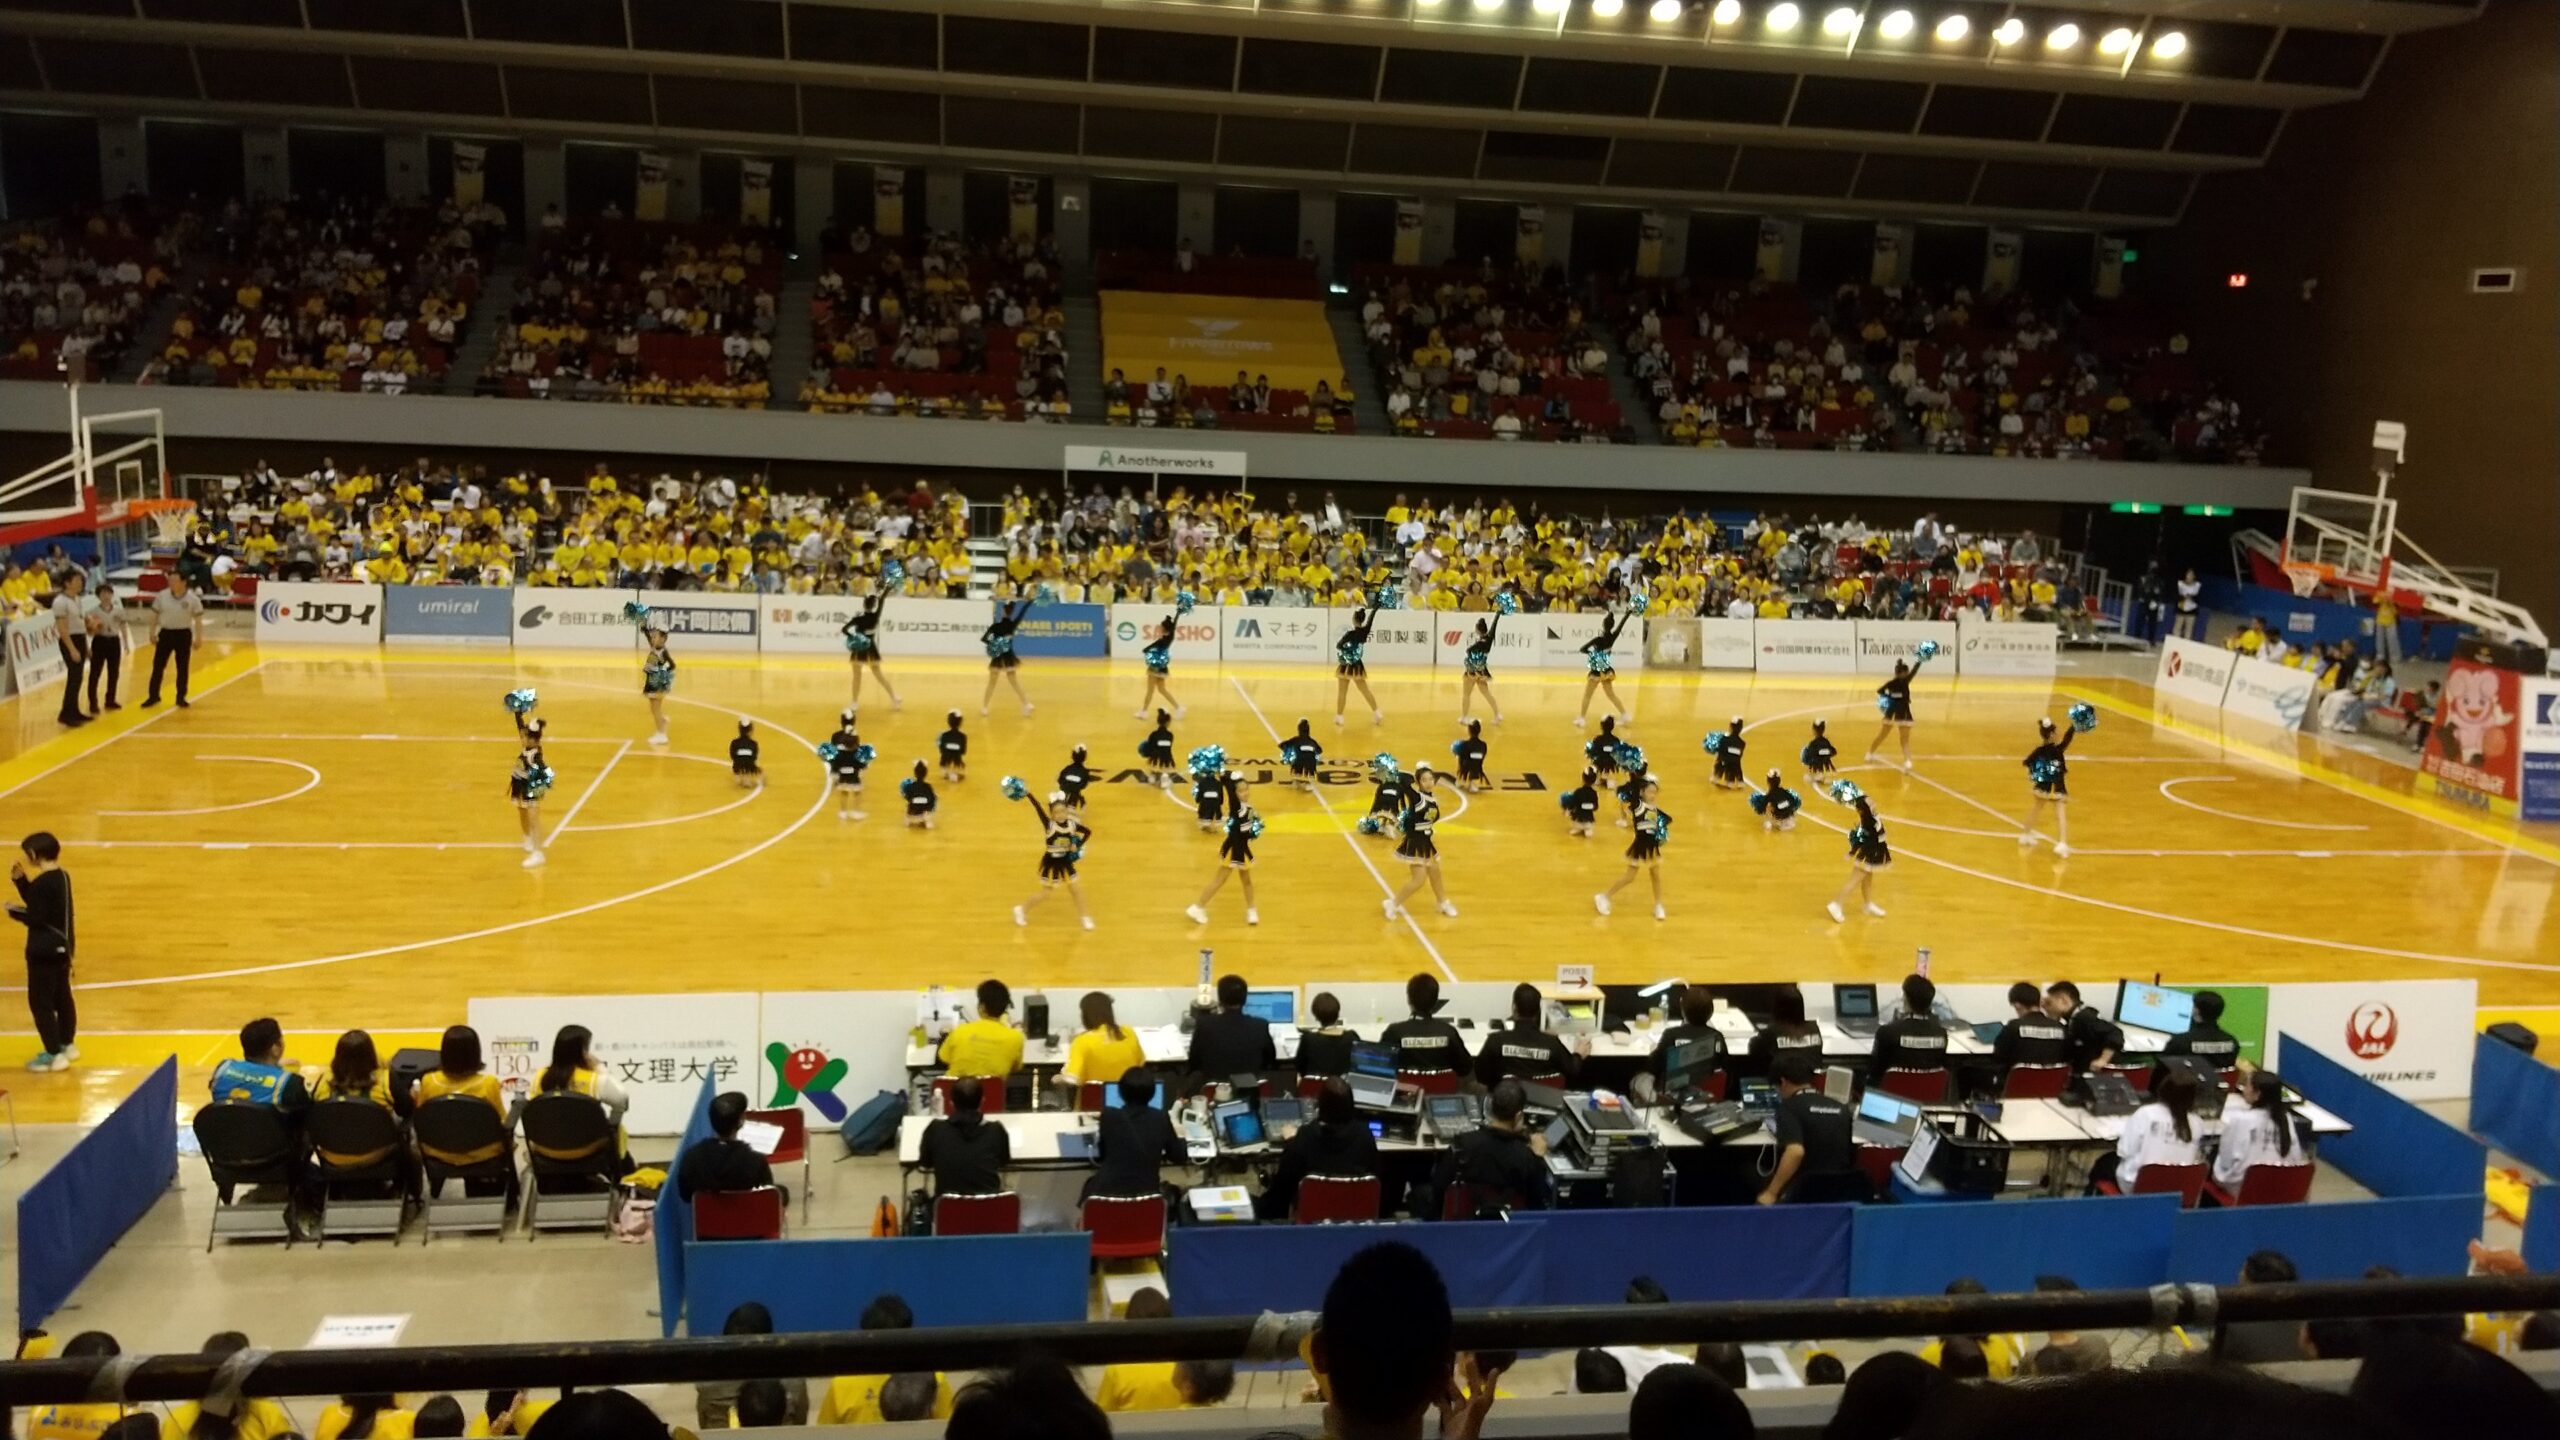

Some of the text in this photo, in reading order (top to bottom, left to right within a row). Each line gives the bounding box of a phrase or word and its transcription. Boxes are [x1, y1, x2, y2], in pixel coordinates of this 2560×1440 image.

[1118, 454, 1215, 469] Anotherworks
[294, 601, 376, 626] カワイ
[418, 598, 480, 615] umiral
[1267, 621, 1318, 637] マキタ
[494, 1054, 531, 1077] 130
[602, 1056, 739, 1084] 文理大学
